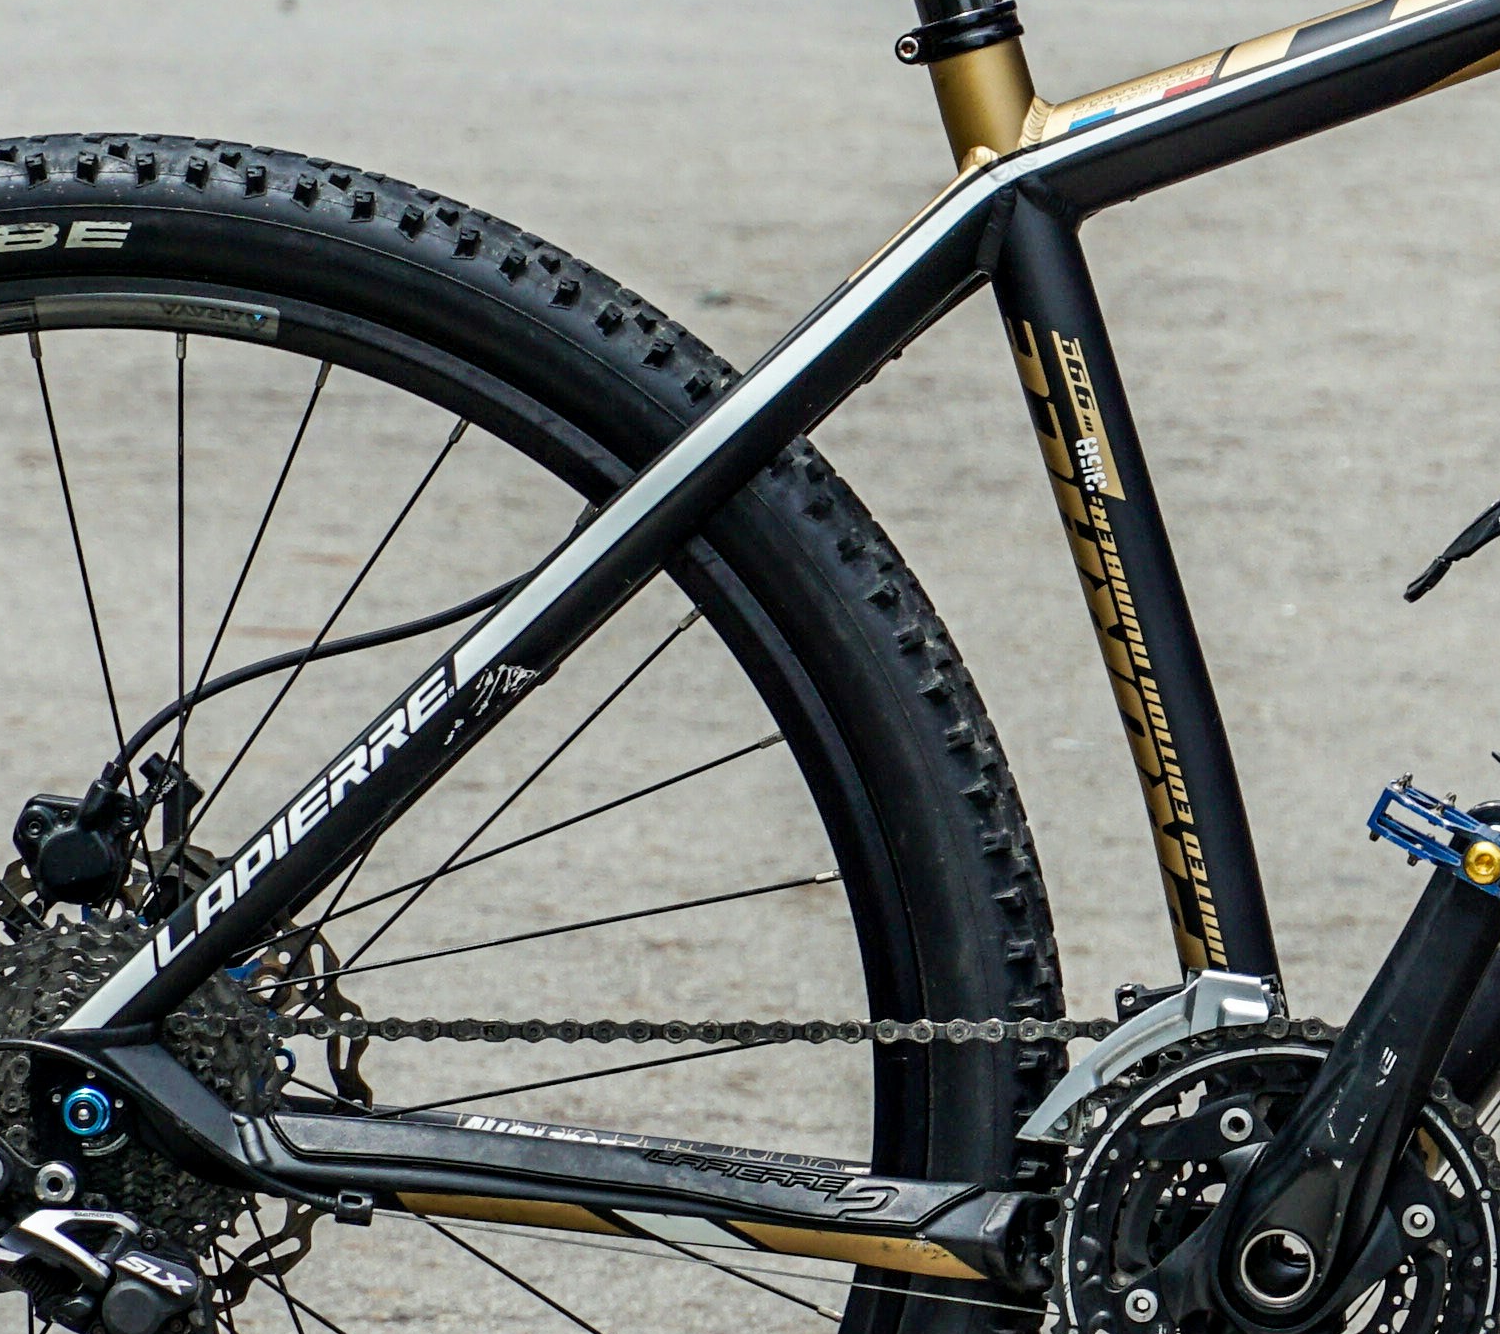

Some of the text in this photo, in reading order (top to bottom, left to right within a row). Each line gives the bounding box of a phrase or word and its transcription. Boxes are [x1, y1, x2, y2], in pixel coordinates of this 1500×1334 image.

[156, 663, 450, 969] LAPIERRE
[1137, 676, 1192, 826] EDITION
[114, 1255, 193, 1297] SLX
